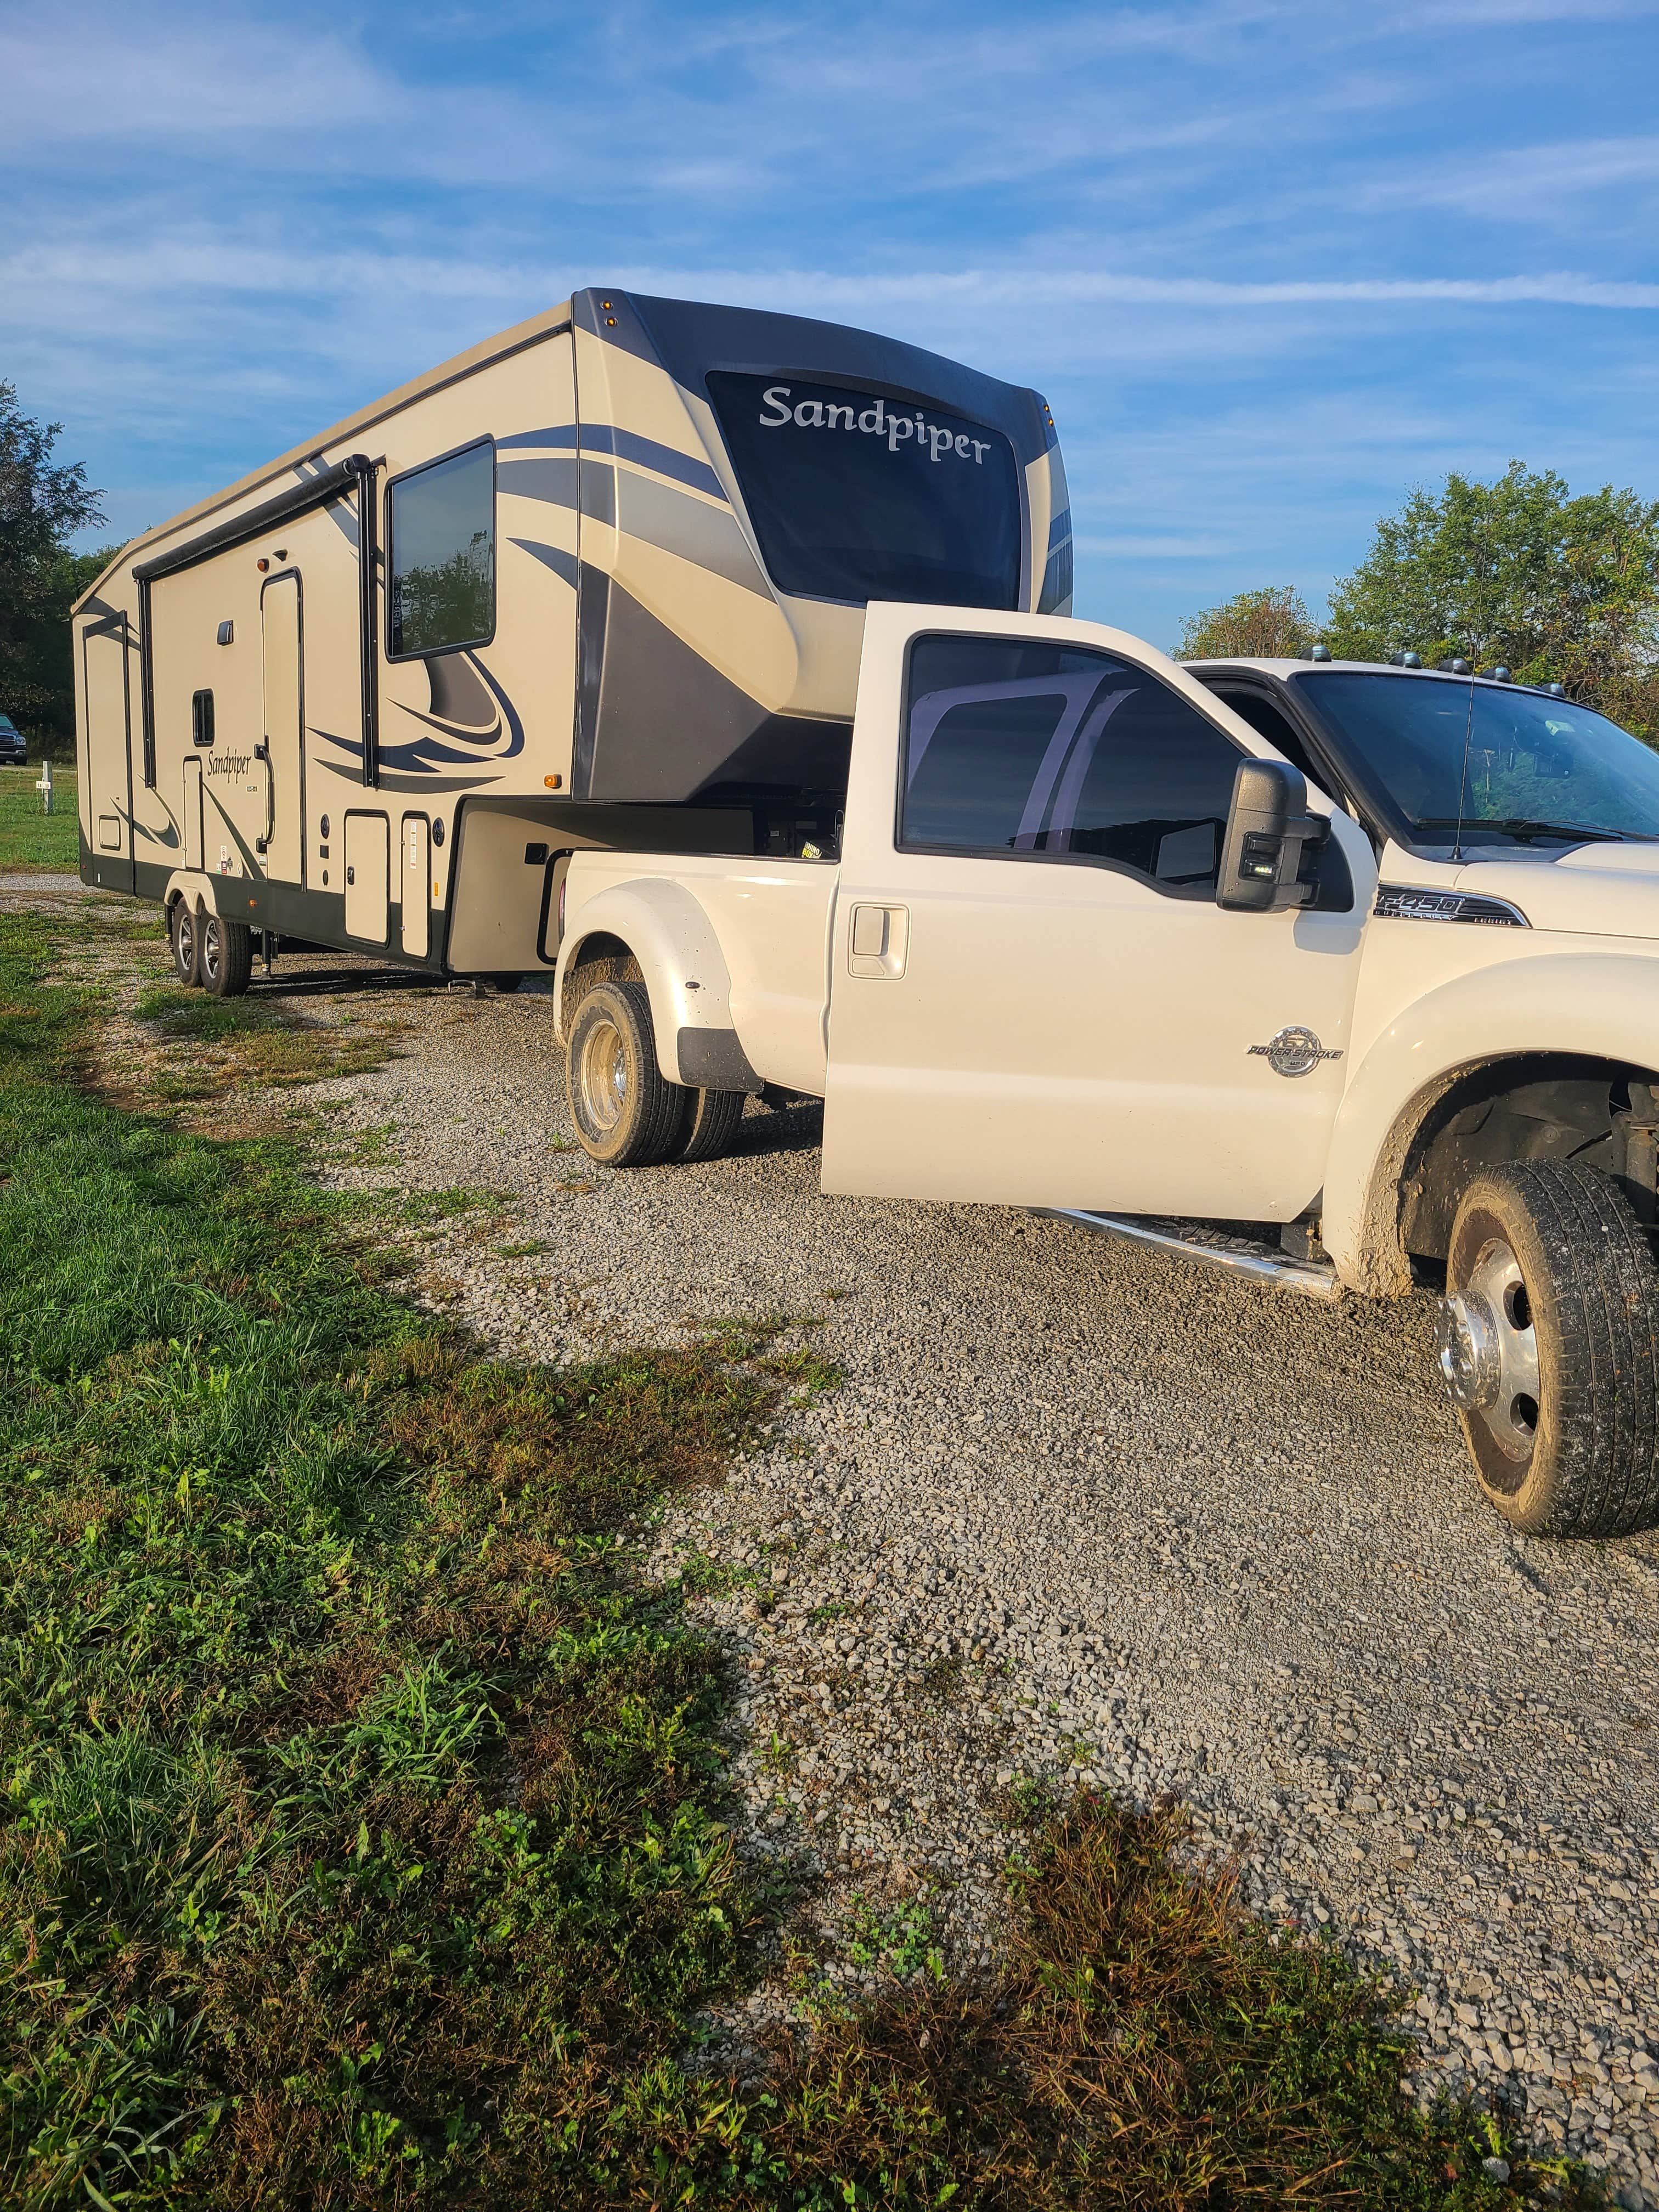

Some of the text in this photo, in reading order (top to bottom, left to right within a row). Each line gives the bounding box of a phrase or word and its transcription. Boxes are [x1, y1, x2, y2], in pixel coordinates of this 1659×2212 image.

[759, 387, 991, 464] Sandpiper
[207, 746, 251, 784] Sandpiper
[803, 848, 813, 859] BOX
[804, 841, 820, 855] RHINO
